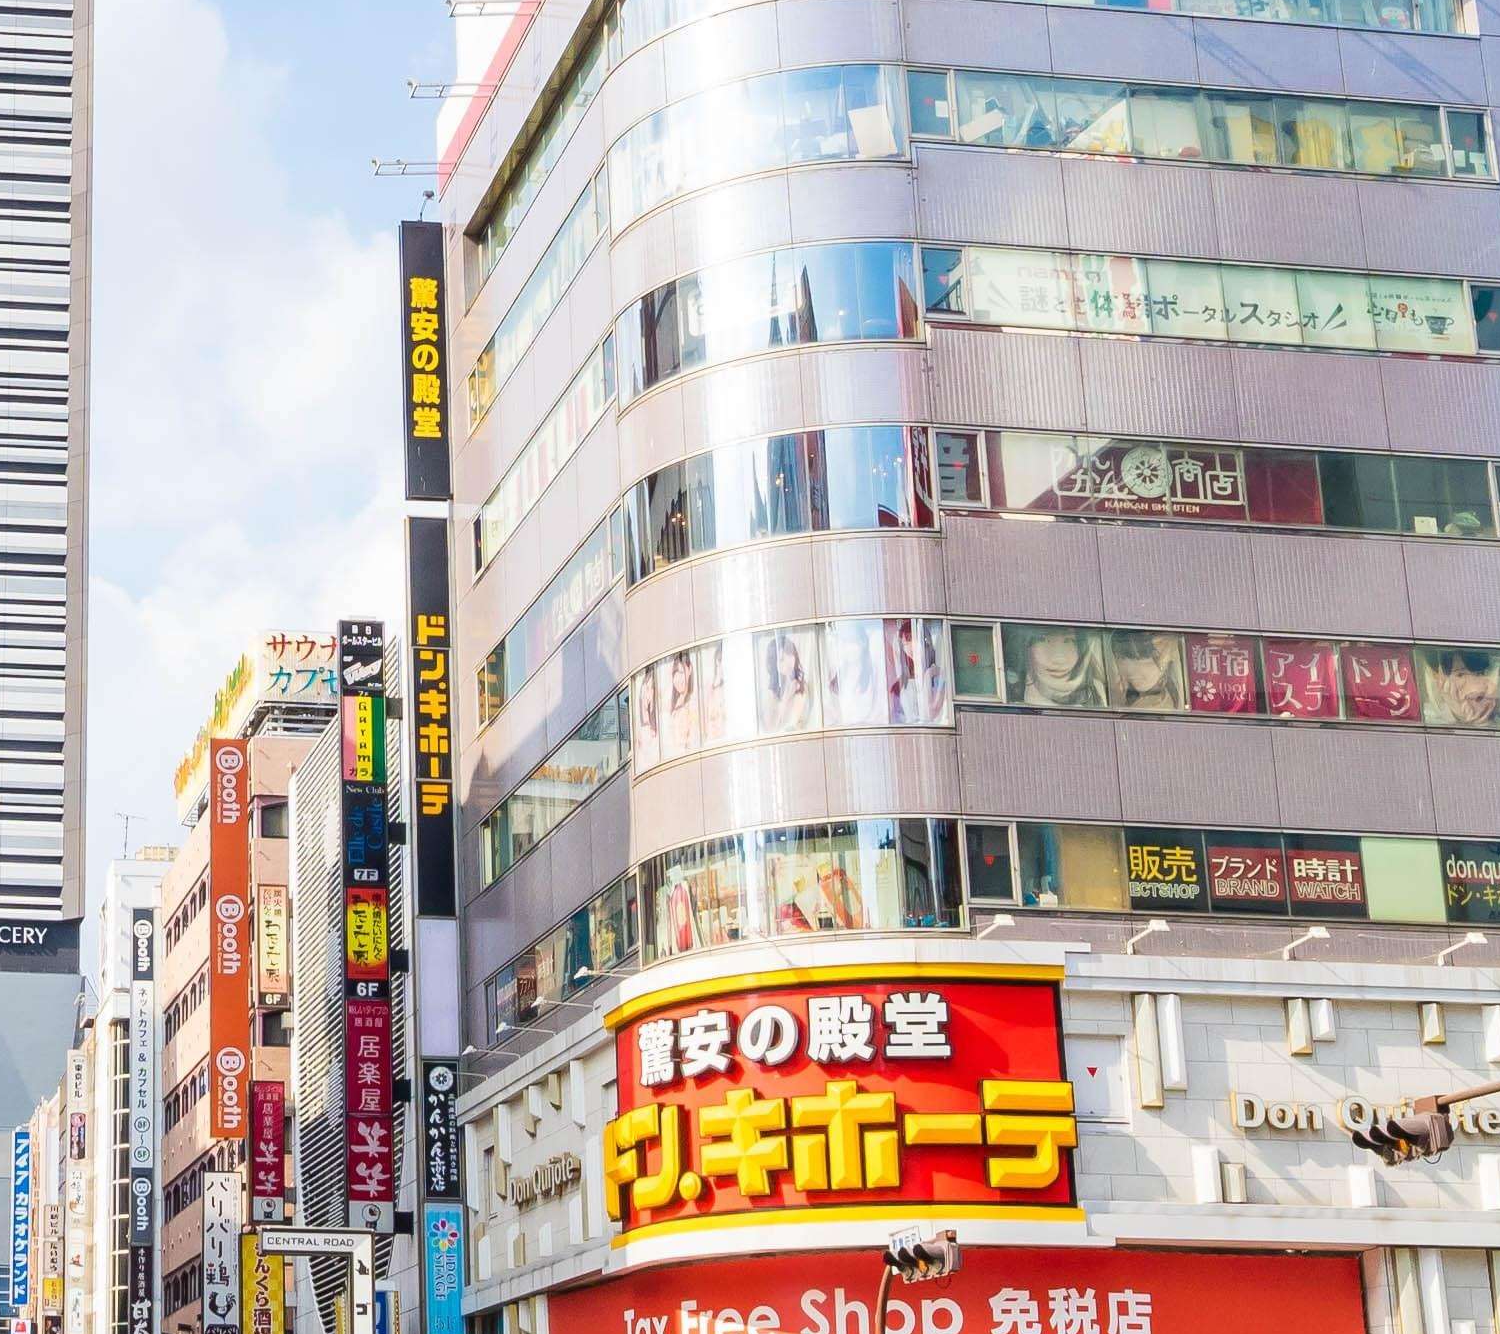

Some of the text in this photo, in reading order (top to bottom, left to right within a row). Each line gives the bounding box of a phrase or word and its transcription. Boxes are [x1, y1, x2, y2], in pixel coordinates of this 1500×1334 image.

[409, 276, 442, 440] 驚安の殿堂
[353, 868, 379, 882] 7F
[1126, 845, 1198, 882] 販売
[1210, 856, 1279, 878] ブランド
[1292, 857, 1360, 883] 時計
[1214, 877, 1281, 899] BRAND
[1295, 880, 1362, 904] WATCH
[355, 981, 379, 998] 6F
[636, 992, 952, 1088] 驚安の殿堂
[357, 1034, 381, 1111] 居楽屋
[604, 1079, 1077, 1222] ドン・キホーテ
[266, 1236, 355, 1247] CENTRAL ROAD
